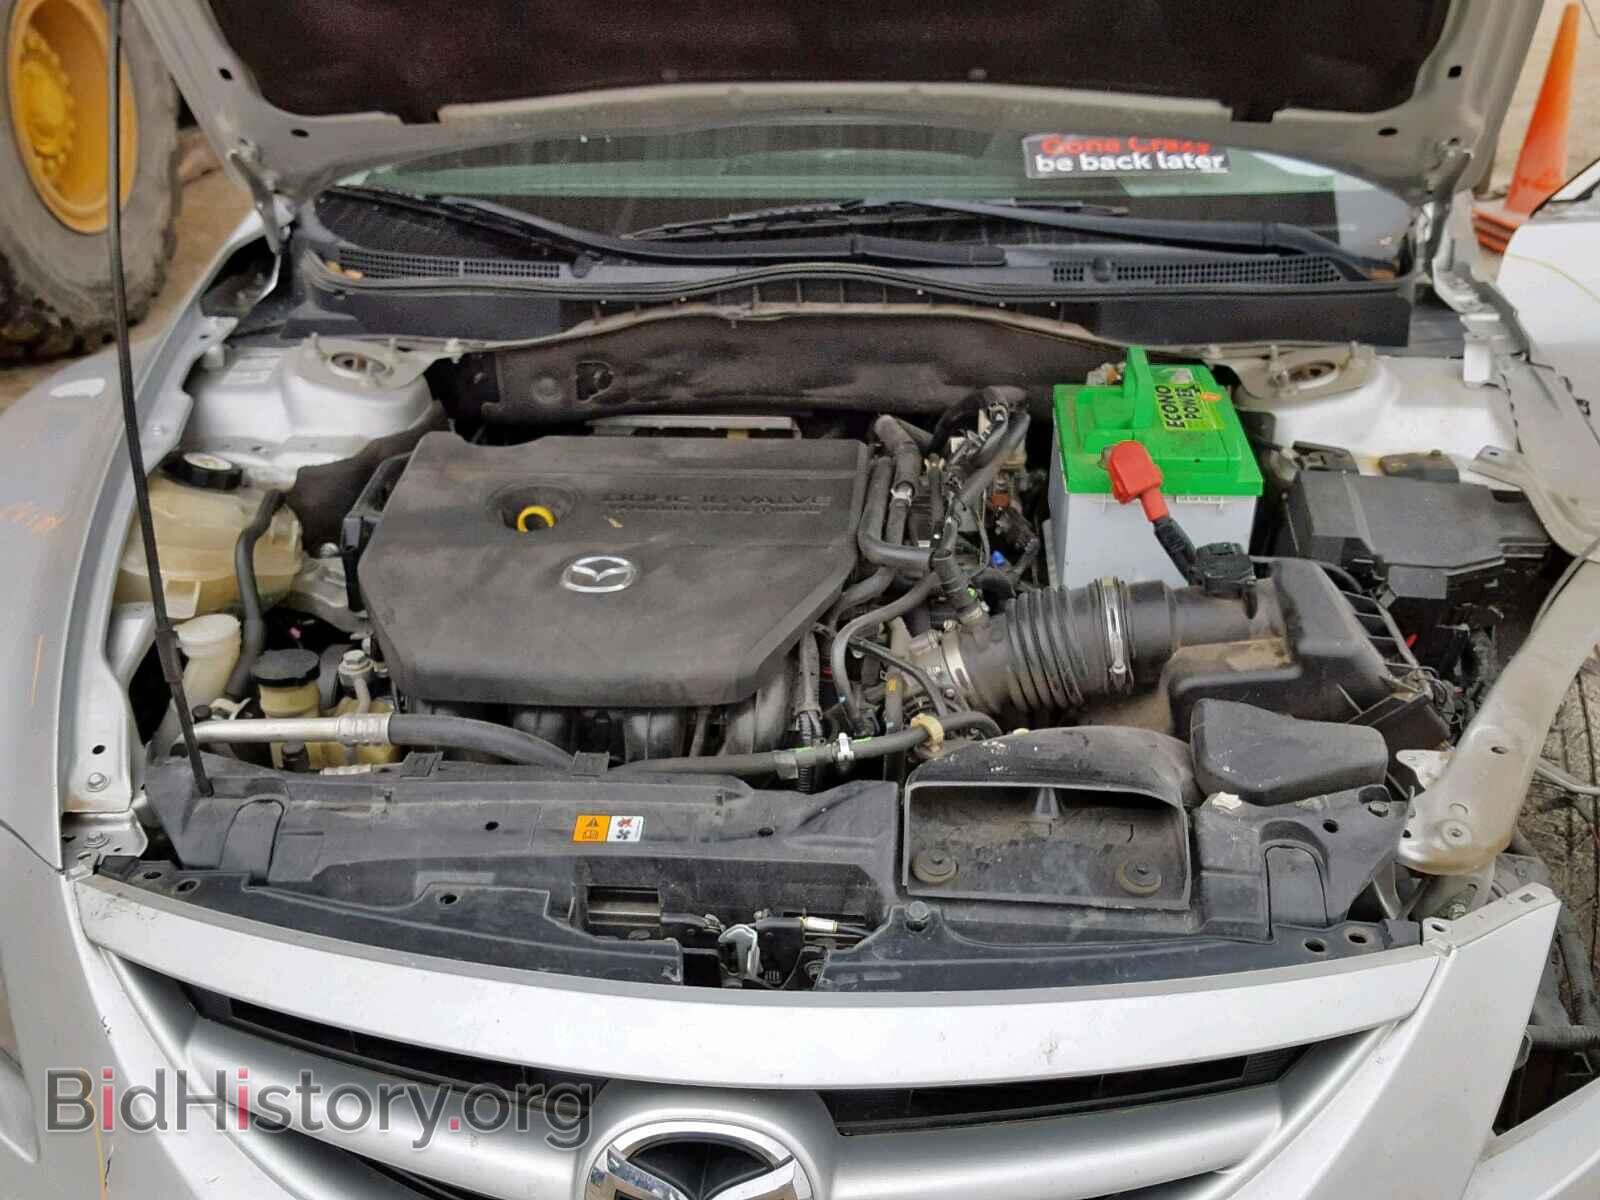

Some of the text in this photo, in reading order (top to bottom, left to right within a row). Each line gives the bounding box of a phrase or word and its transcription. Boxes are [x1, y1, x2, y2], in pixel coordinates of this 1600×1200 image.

[1041, 134, 1120, 155] Gone
[1035, 150, 1224, 172] be back later
[1155, 384, 1186, 429] ECONO
